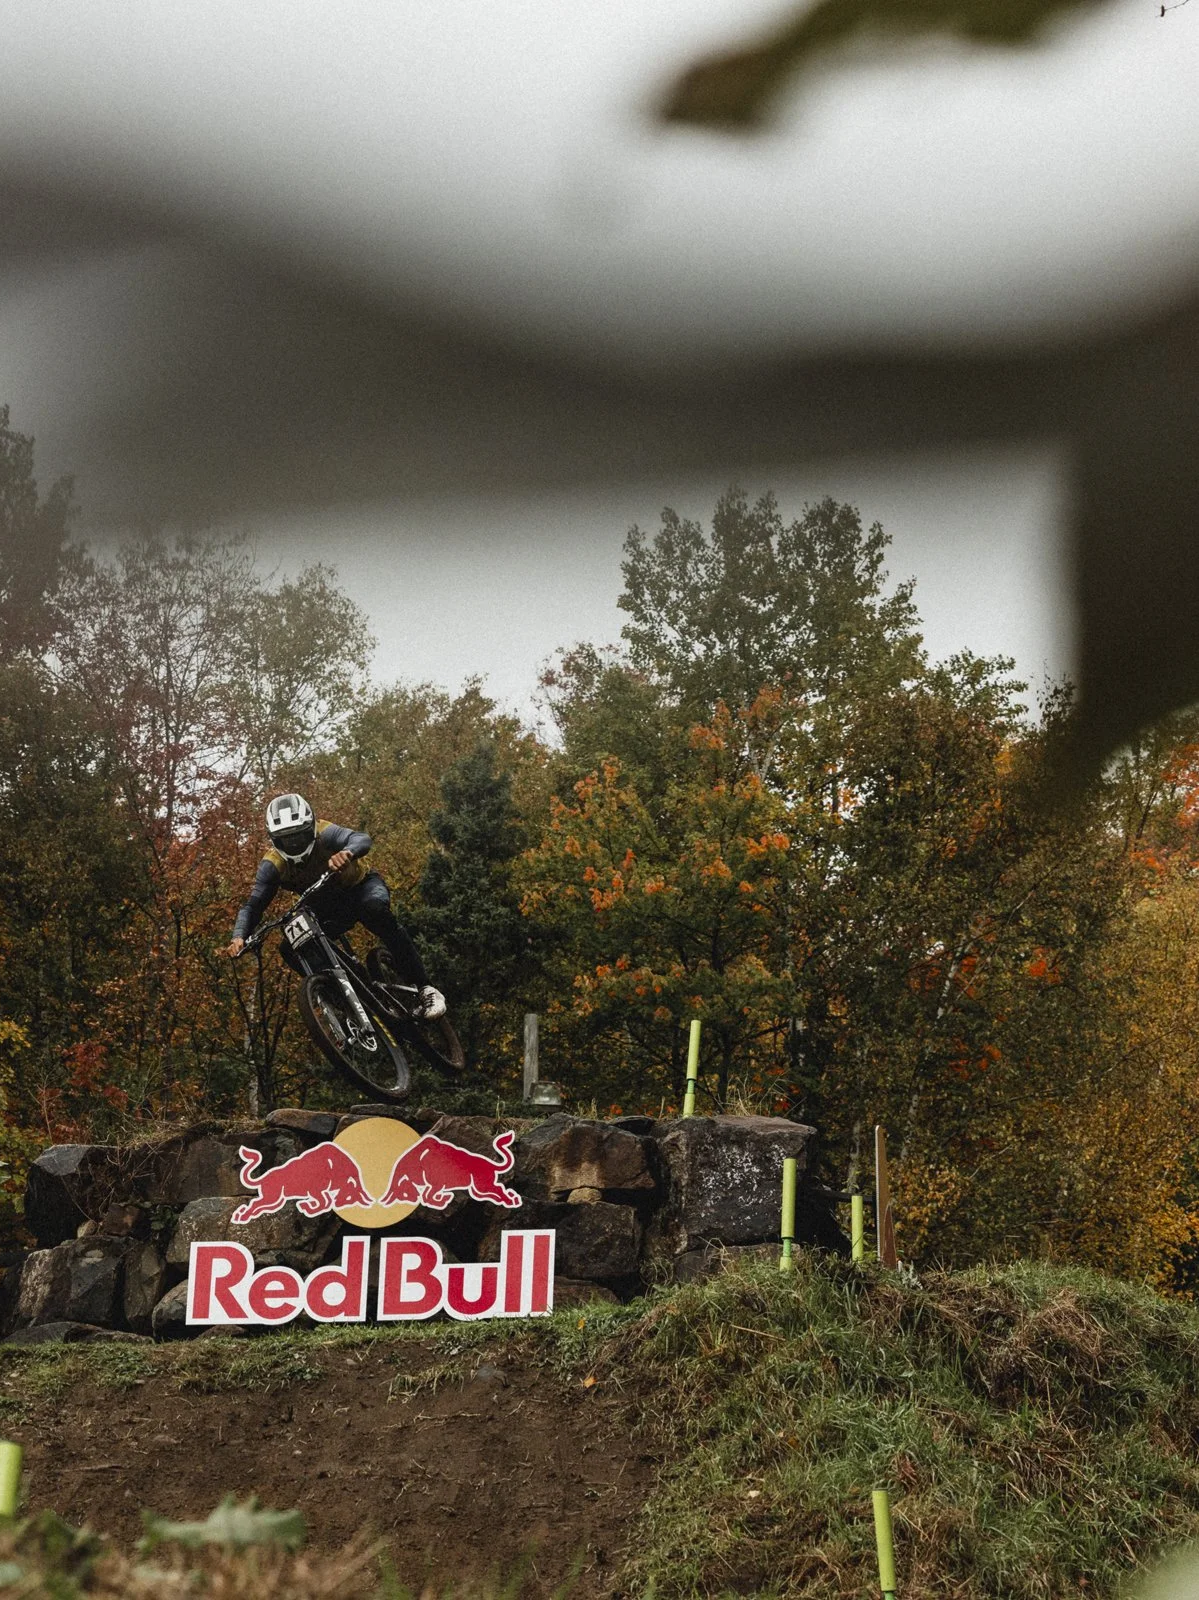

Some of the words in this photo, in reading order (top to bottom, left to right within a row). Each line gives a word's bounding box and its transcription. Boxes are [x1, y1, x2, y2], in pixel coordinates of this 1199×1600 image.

[287, 922, 306, 940] 71
[192, 1241, 365, 1319] Red
[383, 1235, 551, 1316] Bull
